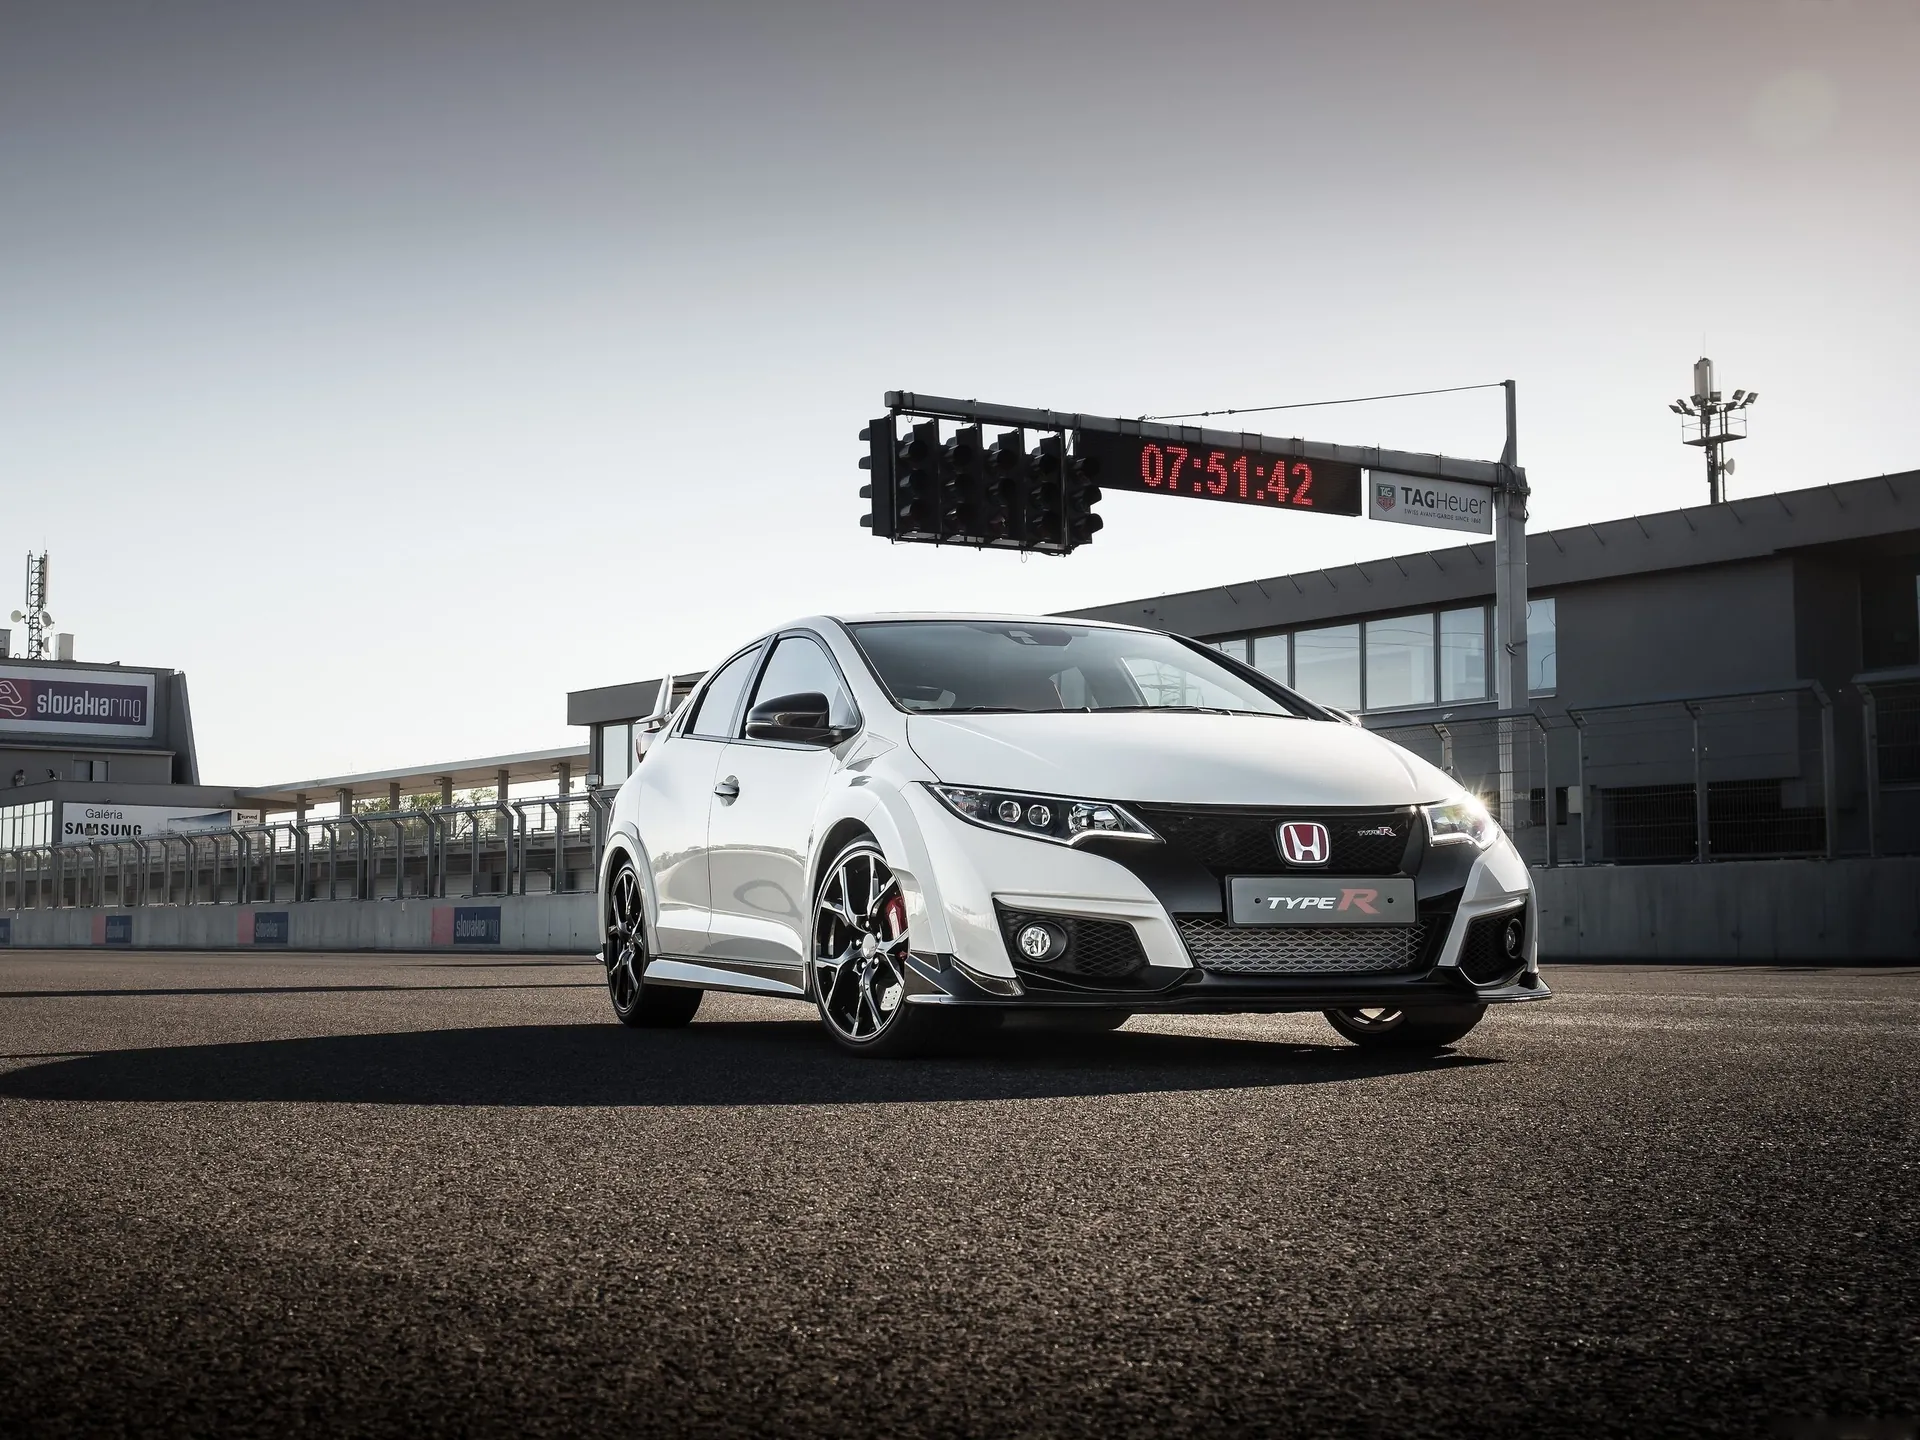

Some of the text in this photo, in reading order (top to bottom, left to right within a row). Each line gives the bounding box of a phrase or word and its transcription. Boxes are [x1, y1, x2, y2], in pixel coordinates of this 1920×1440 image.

[1141, 443, 1313, 506] 07:51:42
[1455, 515, 1470, 523] SINCE
[85, 808, 123, 820] Galéria
[1267, 888, 1381, 915] TYPE R
